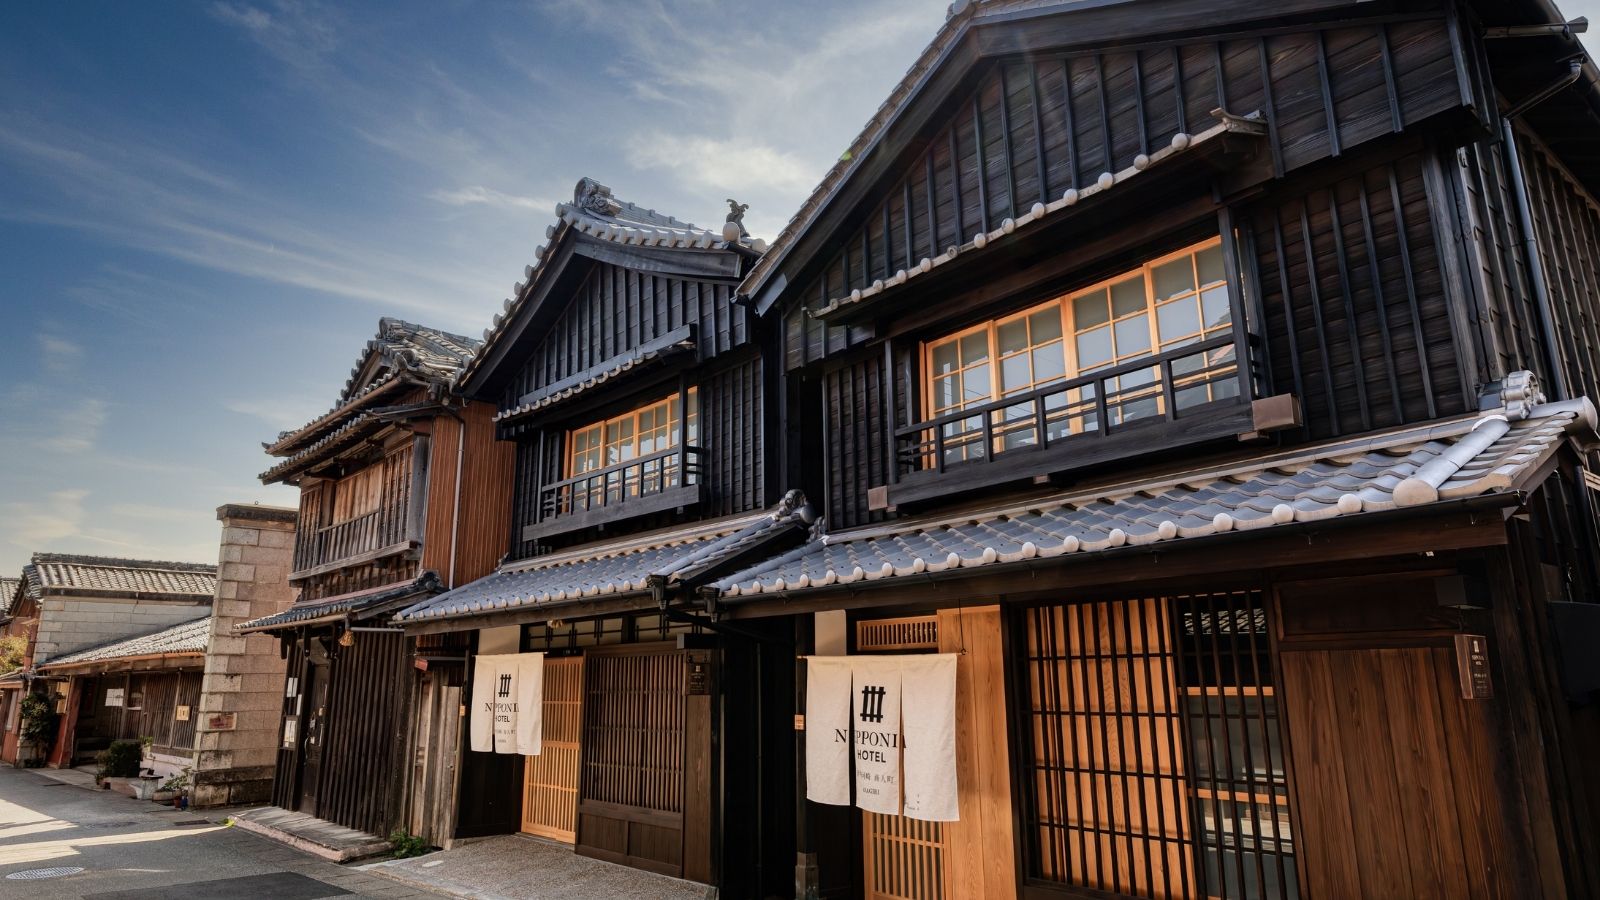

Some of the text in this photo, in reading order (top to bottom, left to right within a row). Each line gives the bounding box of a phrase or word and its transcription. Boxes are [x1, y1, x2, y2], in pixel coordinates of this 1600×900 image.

[484, 702, 520, 713] NPPONI
[834, 728, 907, 749] NPPONI
[857, 750, 887, 763] HOTEL
